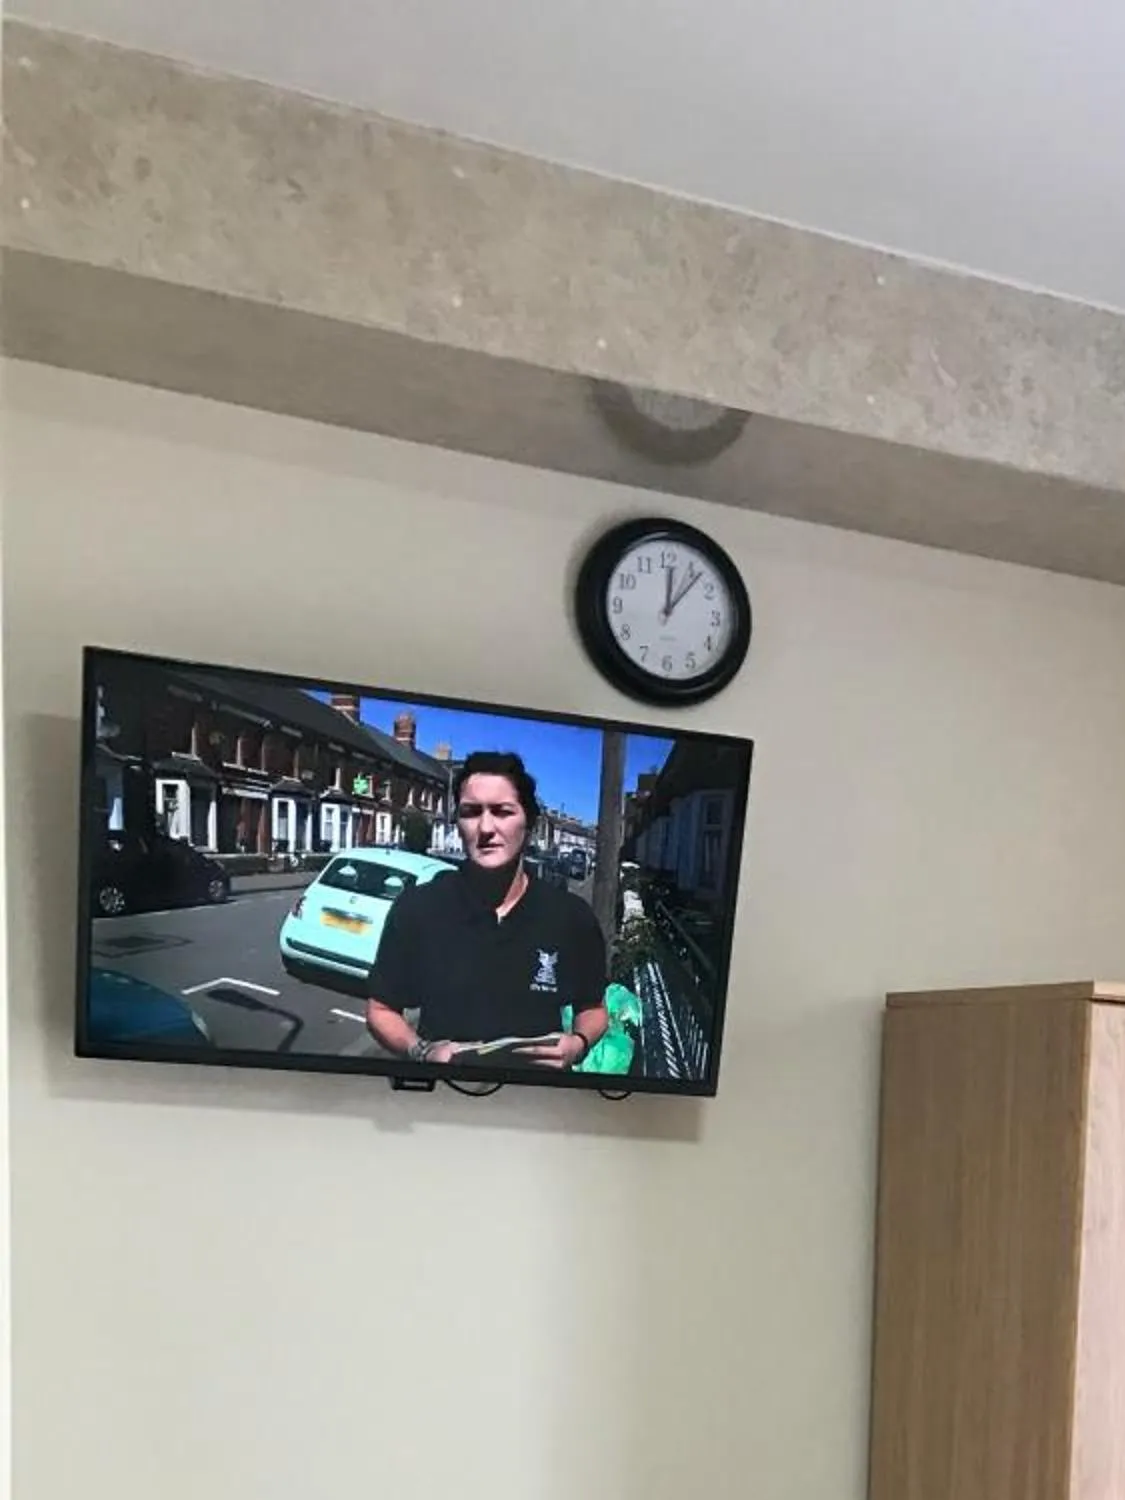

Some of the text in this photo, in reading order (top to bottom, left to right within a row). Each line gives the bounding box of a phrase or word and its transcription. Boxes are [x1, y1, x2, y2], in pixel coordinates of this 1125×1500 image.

[637, 556, 652, 574] 11
[659, 551, 677, 569] 12
[687, 561, 696, 579] 1
[619, 573, 636, 591] 10
[704, 583, 714, 601] 2
[612, 596, 623, 614] 9
[711, 610, 721, 627] 3
[620, 624, 631, 641] 8
[703, 635, 712, 652] 4
[639, 645, 649, 663] 7
[685, 652, 696, 669] 5
[662, 655, 673, 673] 6
